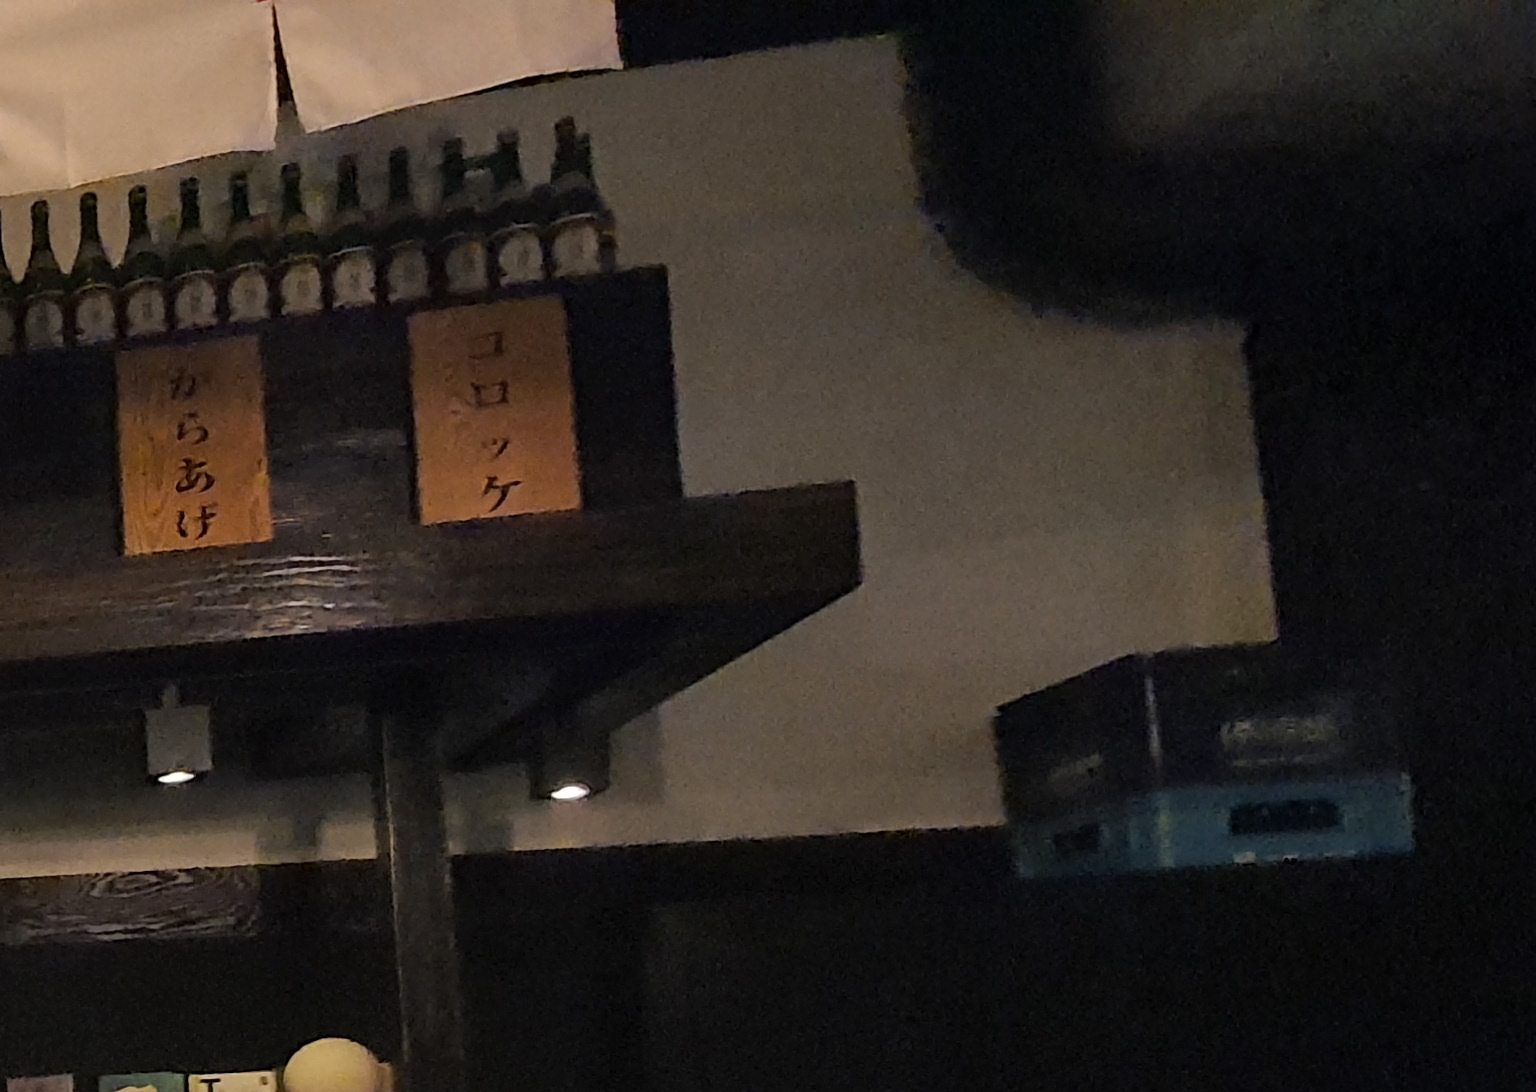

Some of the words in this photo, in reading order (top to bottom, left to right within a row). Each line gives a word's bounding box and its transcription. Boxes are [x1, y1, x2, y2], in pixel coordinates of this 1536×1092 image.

[169, 368, 218, 541] からあげ
[468, 330, 522, 513] コロッケ
